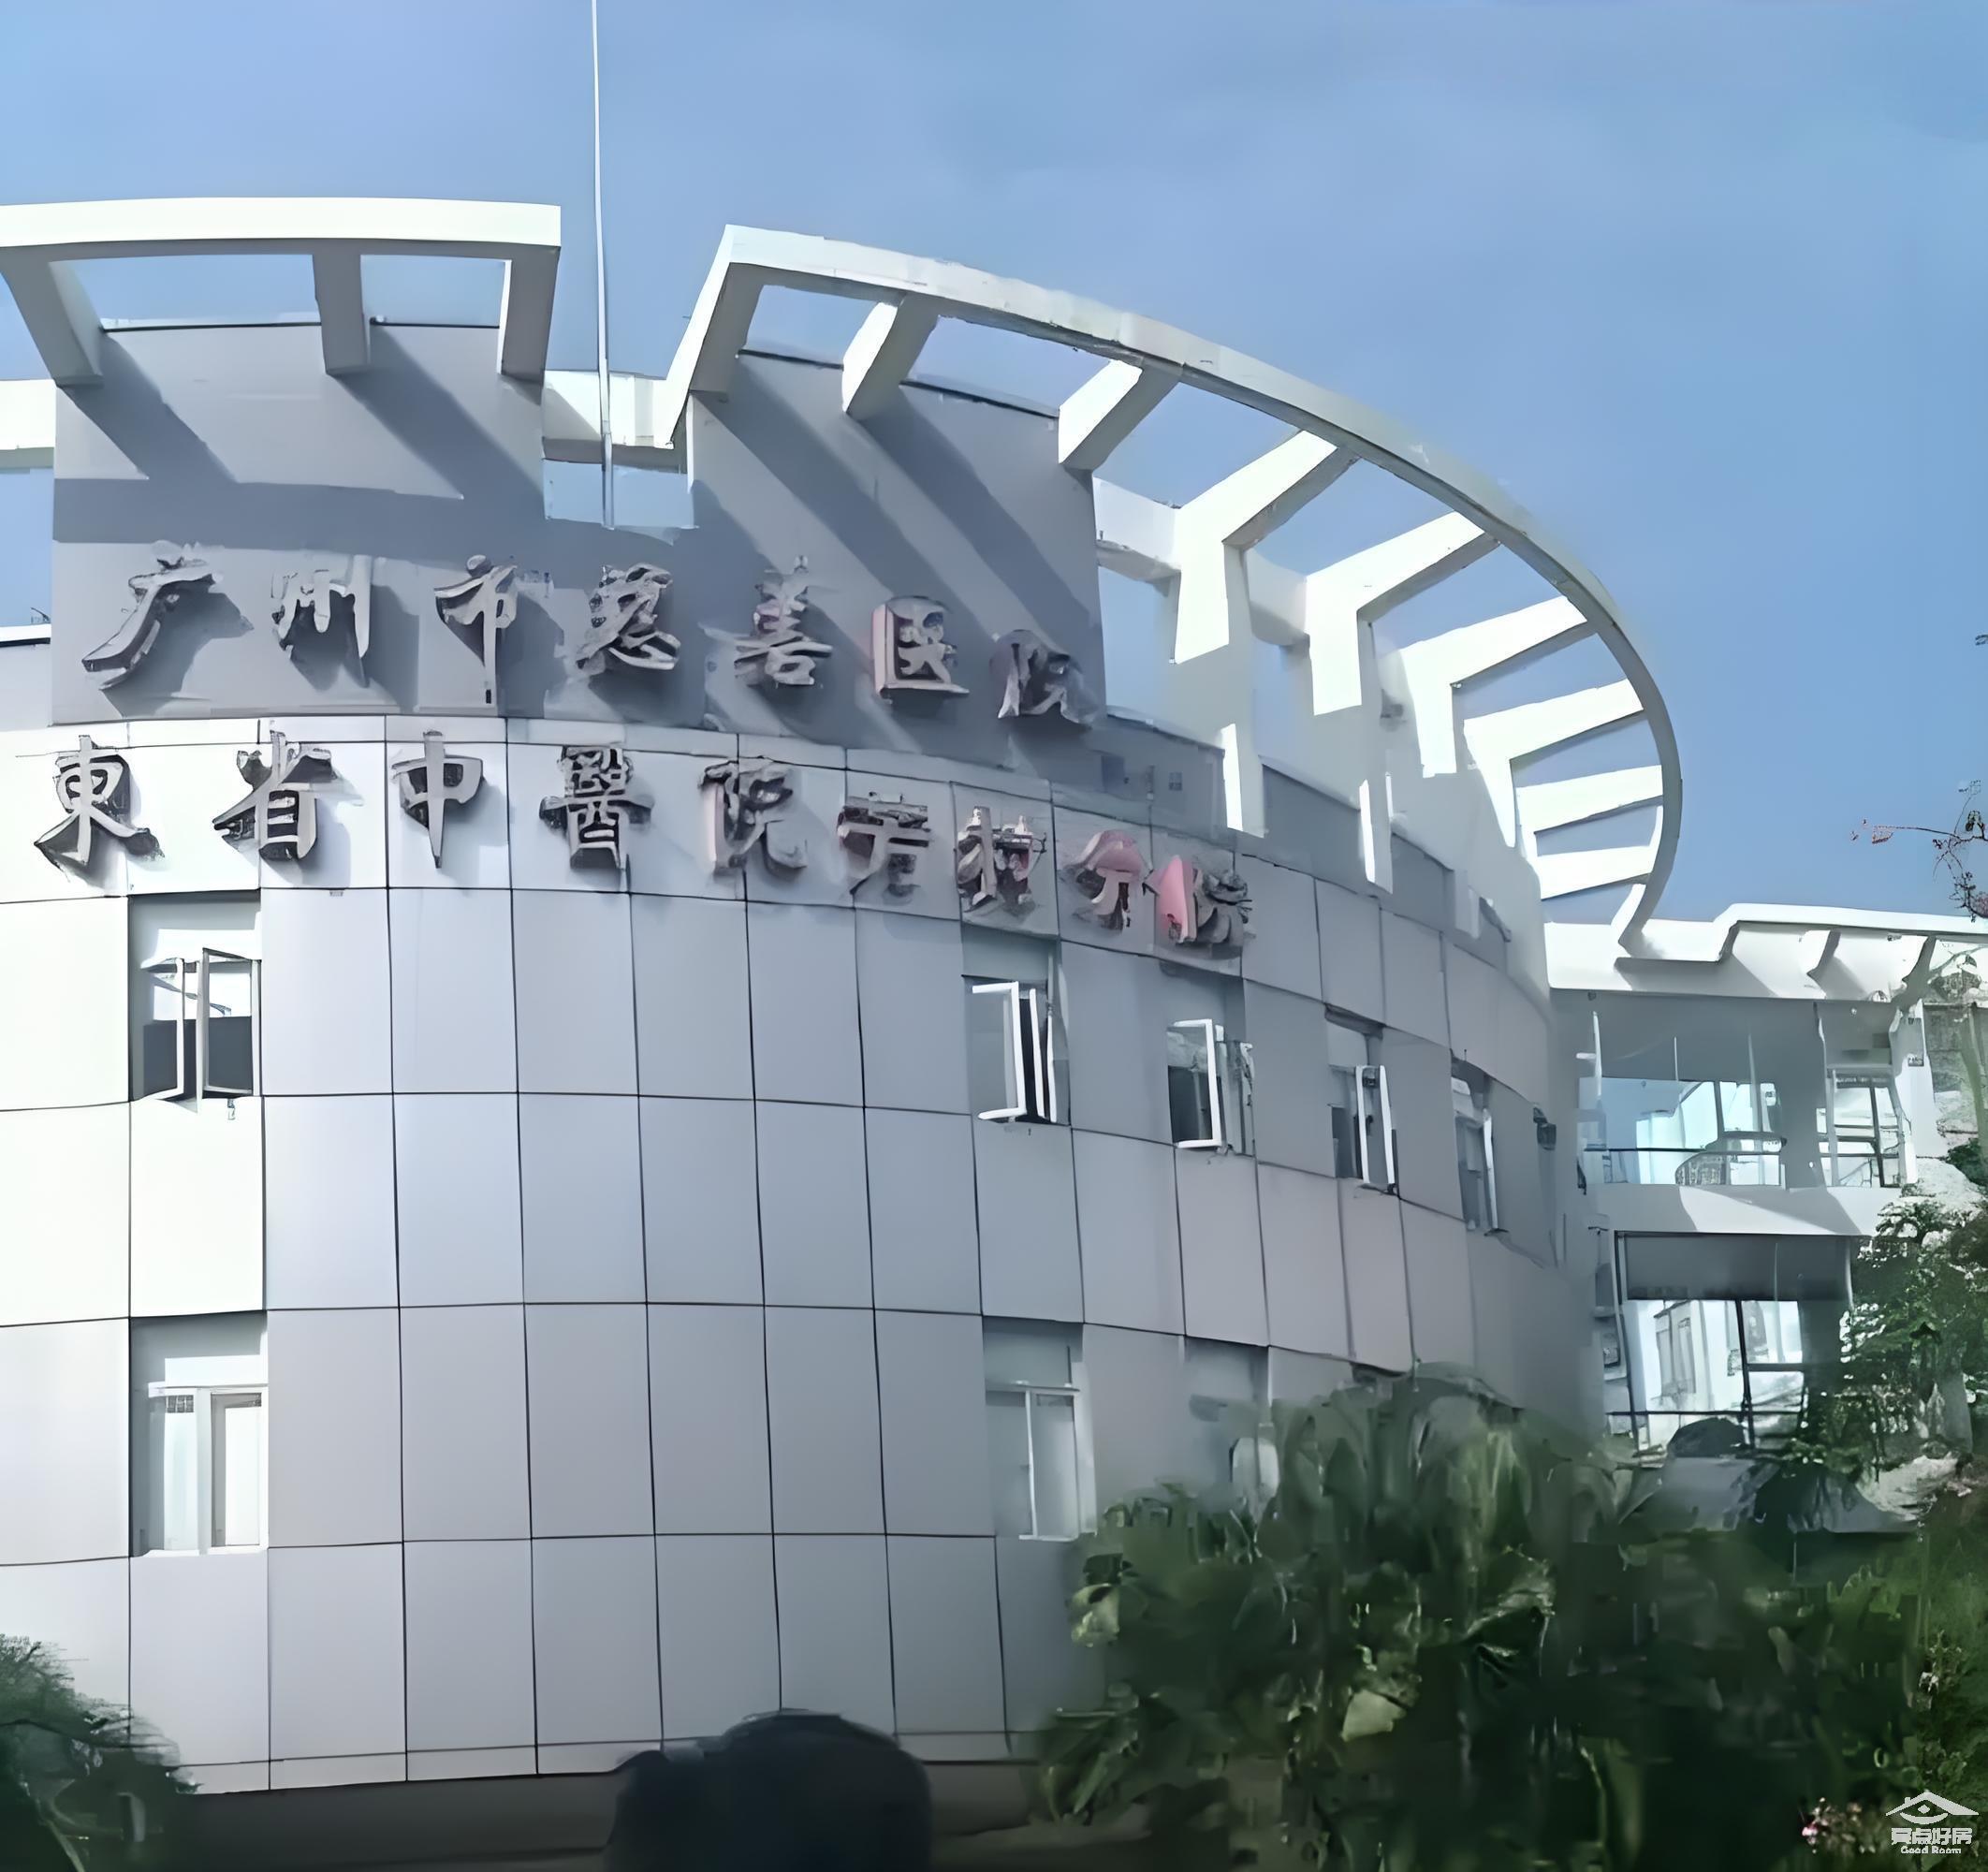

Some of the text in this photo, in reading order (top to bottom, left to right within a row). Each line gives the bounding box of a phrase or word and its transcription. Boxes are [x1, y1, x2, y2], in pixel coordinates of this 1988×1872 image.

[82, 541, 1097, 732] 广州市慈善医院
